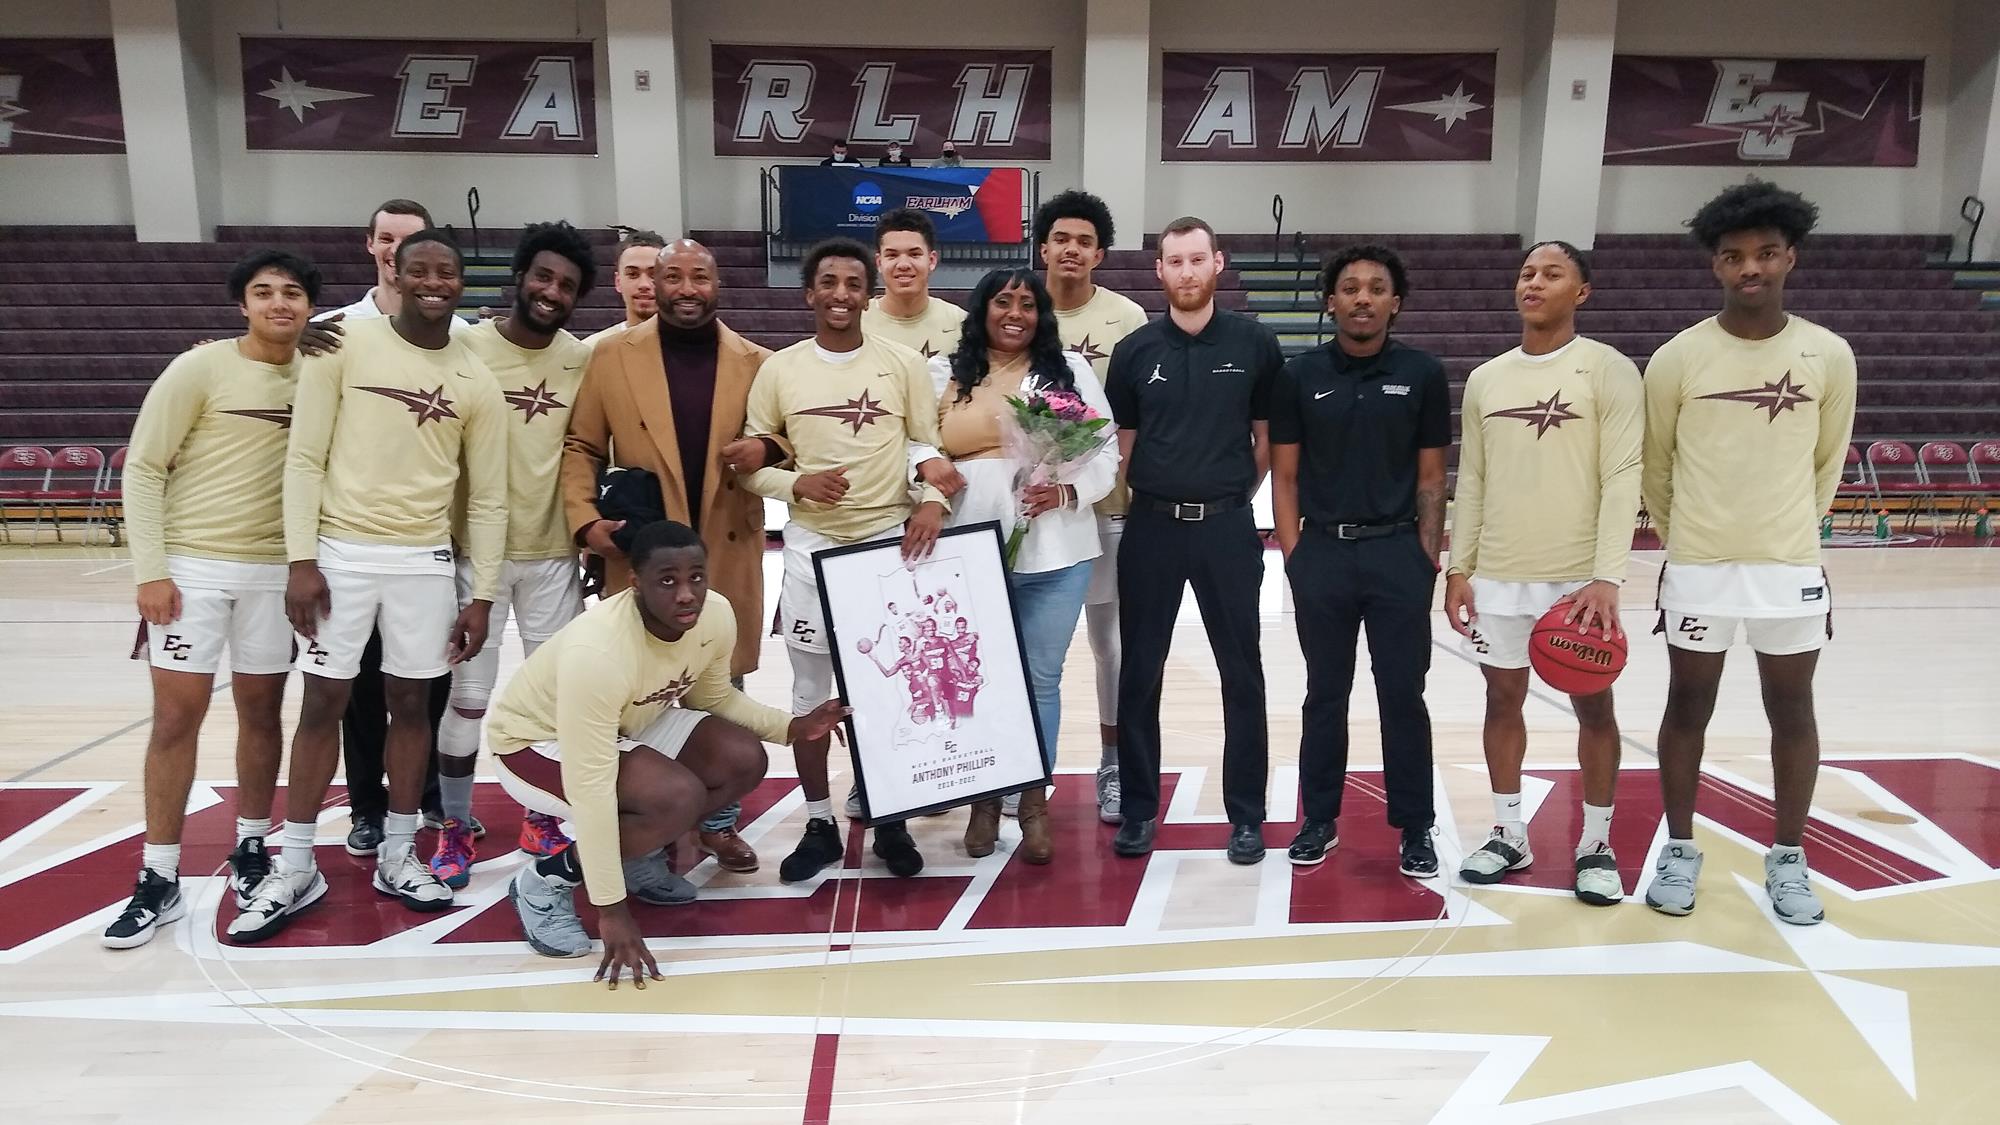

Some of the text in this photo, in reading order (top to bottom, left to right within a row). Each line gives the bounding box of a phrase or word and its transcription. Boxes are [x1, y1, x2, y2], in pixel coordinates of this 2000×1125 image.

[855, 196, 882, 205] NCAA
[905, 196, 974, 210] EARLHAM
[1679, 616, 1709, 641] EC
[1549, 635, 1612, 666] Wilson
[912, 755, 996, 784] ANTHONY PHILLIPS
